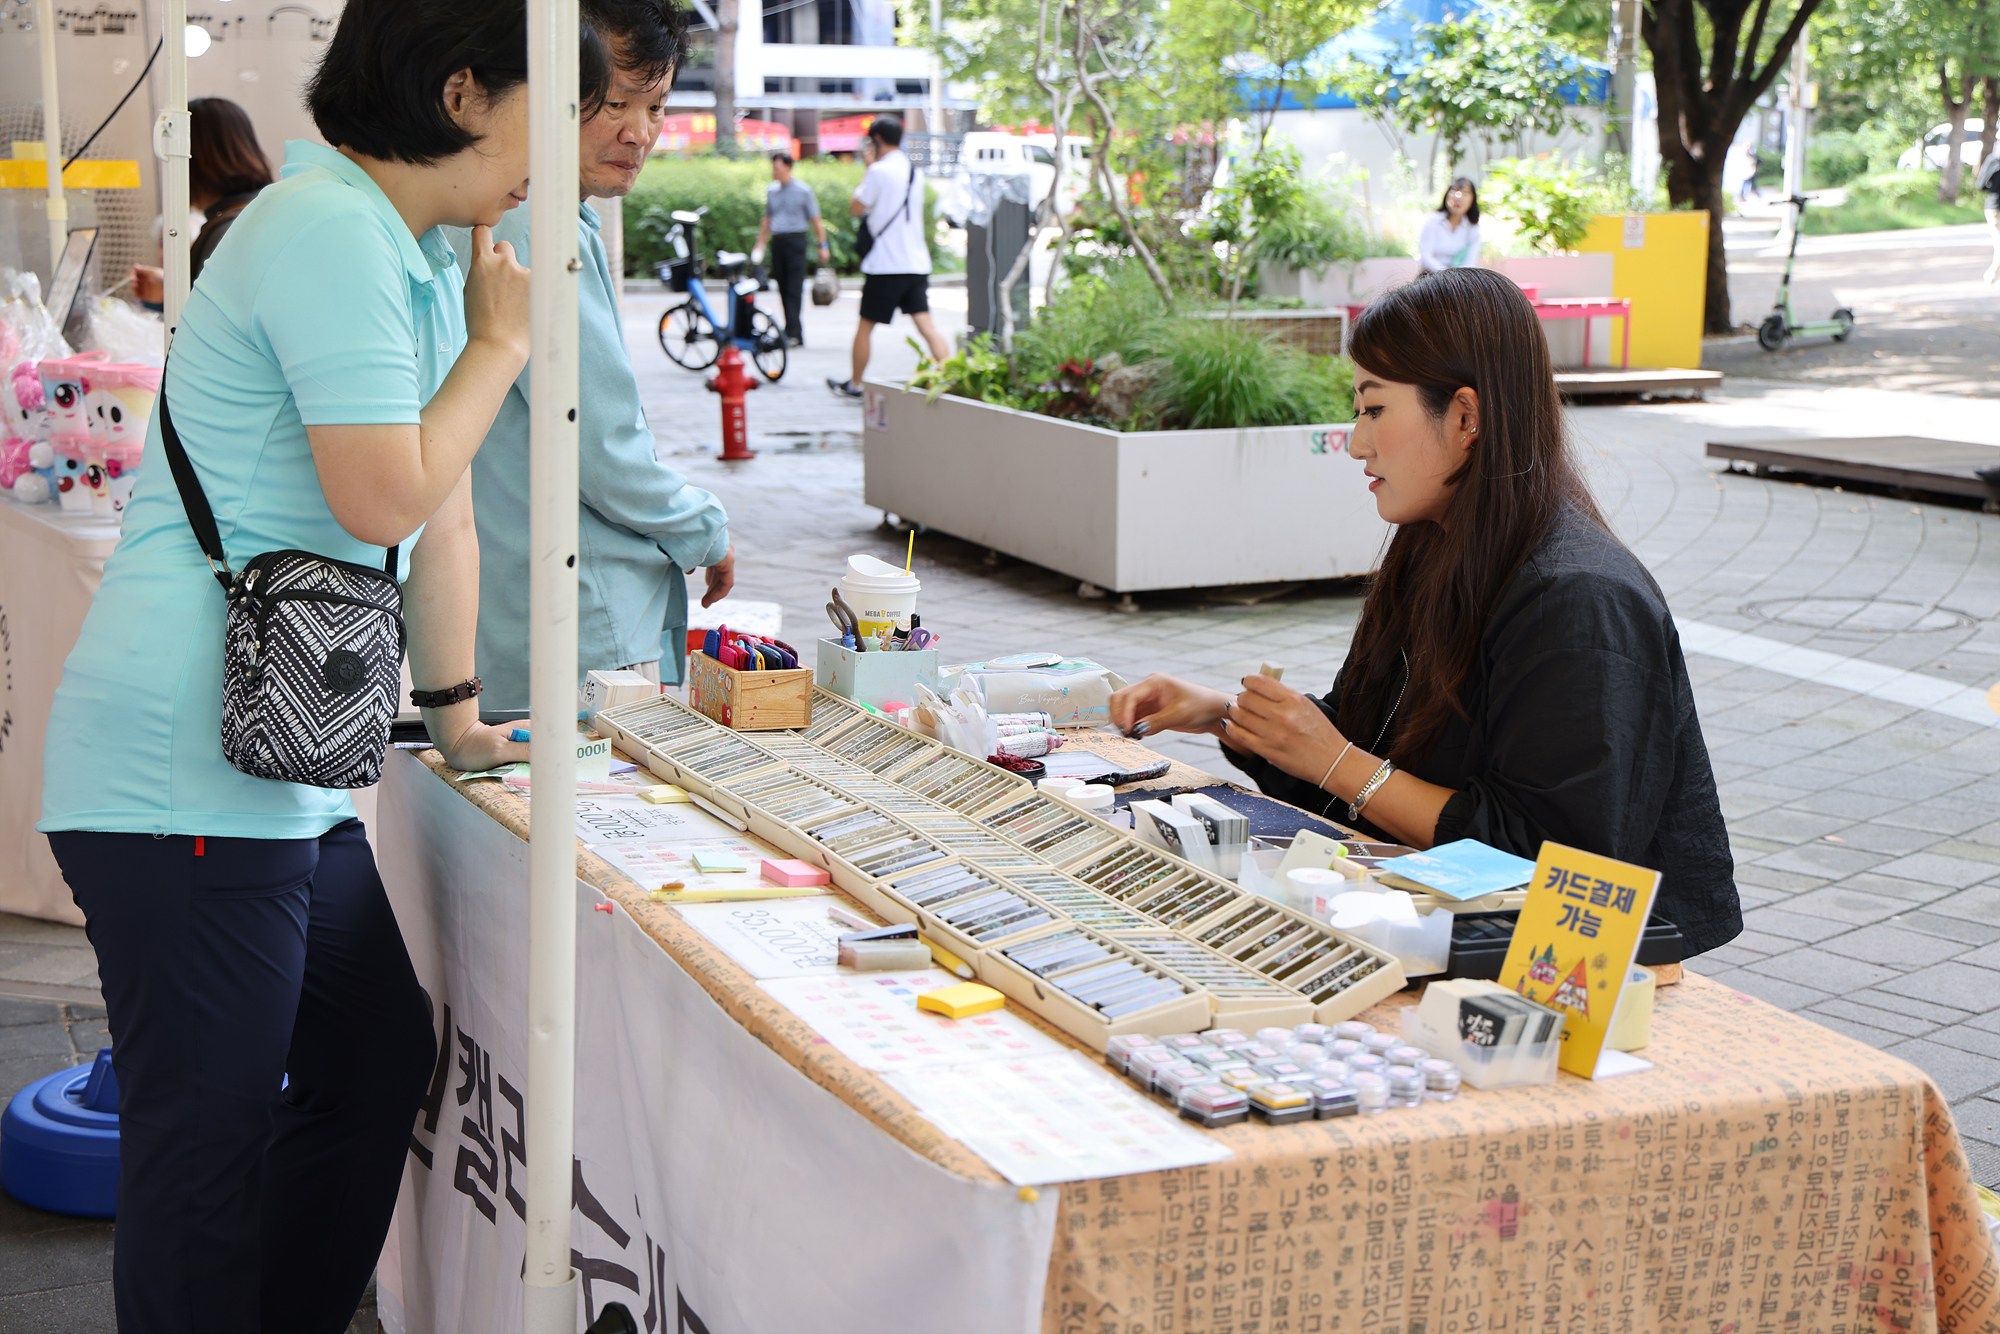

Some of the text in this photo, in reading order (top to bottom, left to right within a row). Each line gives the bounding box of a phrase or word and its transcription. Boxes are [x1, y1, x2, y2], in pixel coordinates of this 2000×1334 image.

[865, 610, 902, 618] MEGA COFFEE
[1018, 694, 1036, 706] Bon
[1544, 866, 1637, 915] 카드결제
[732, 910, 838, 968] 35,000원
[1556, 903, 1602, 939] 가능
